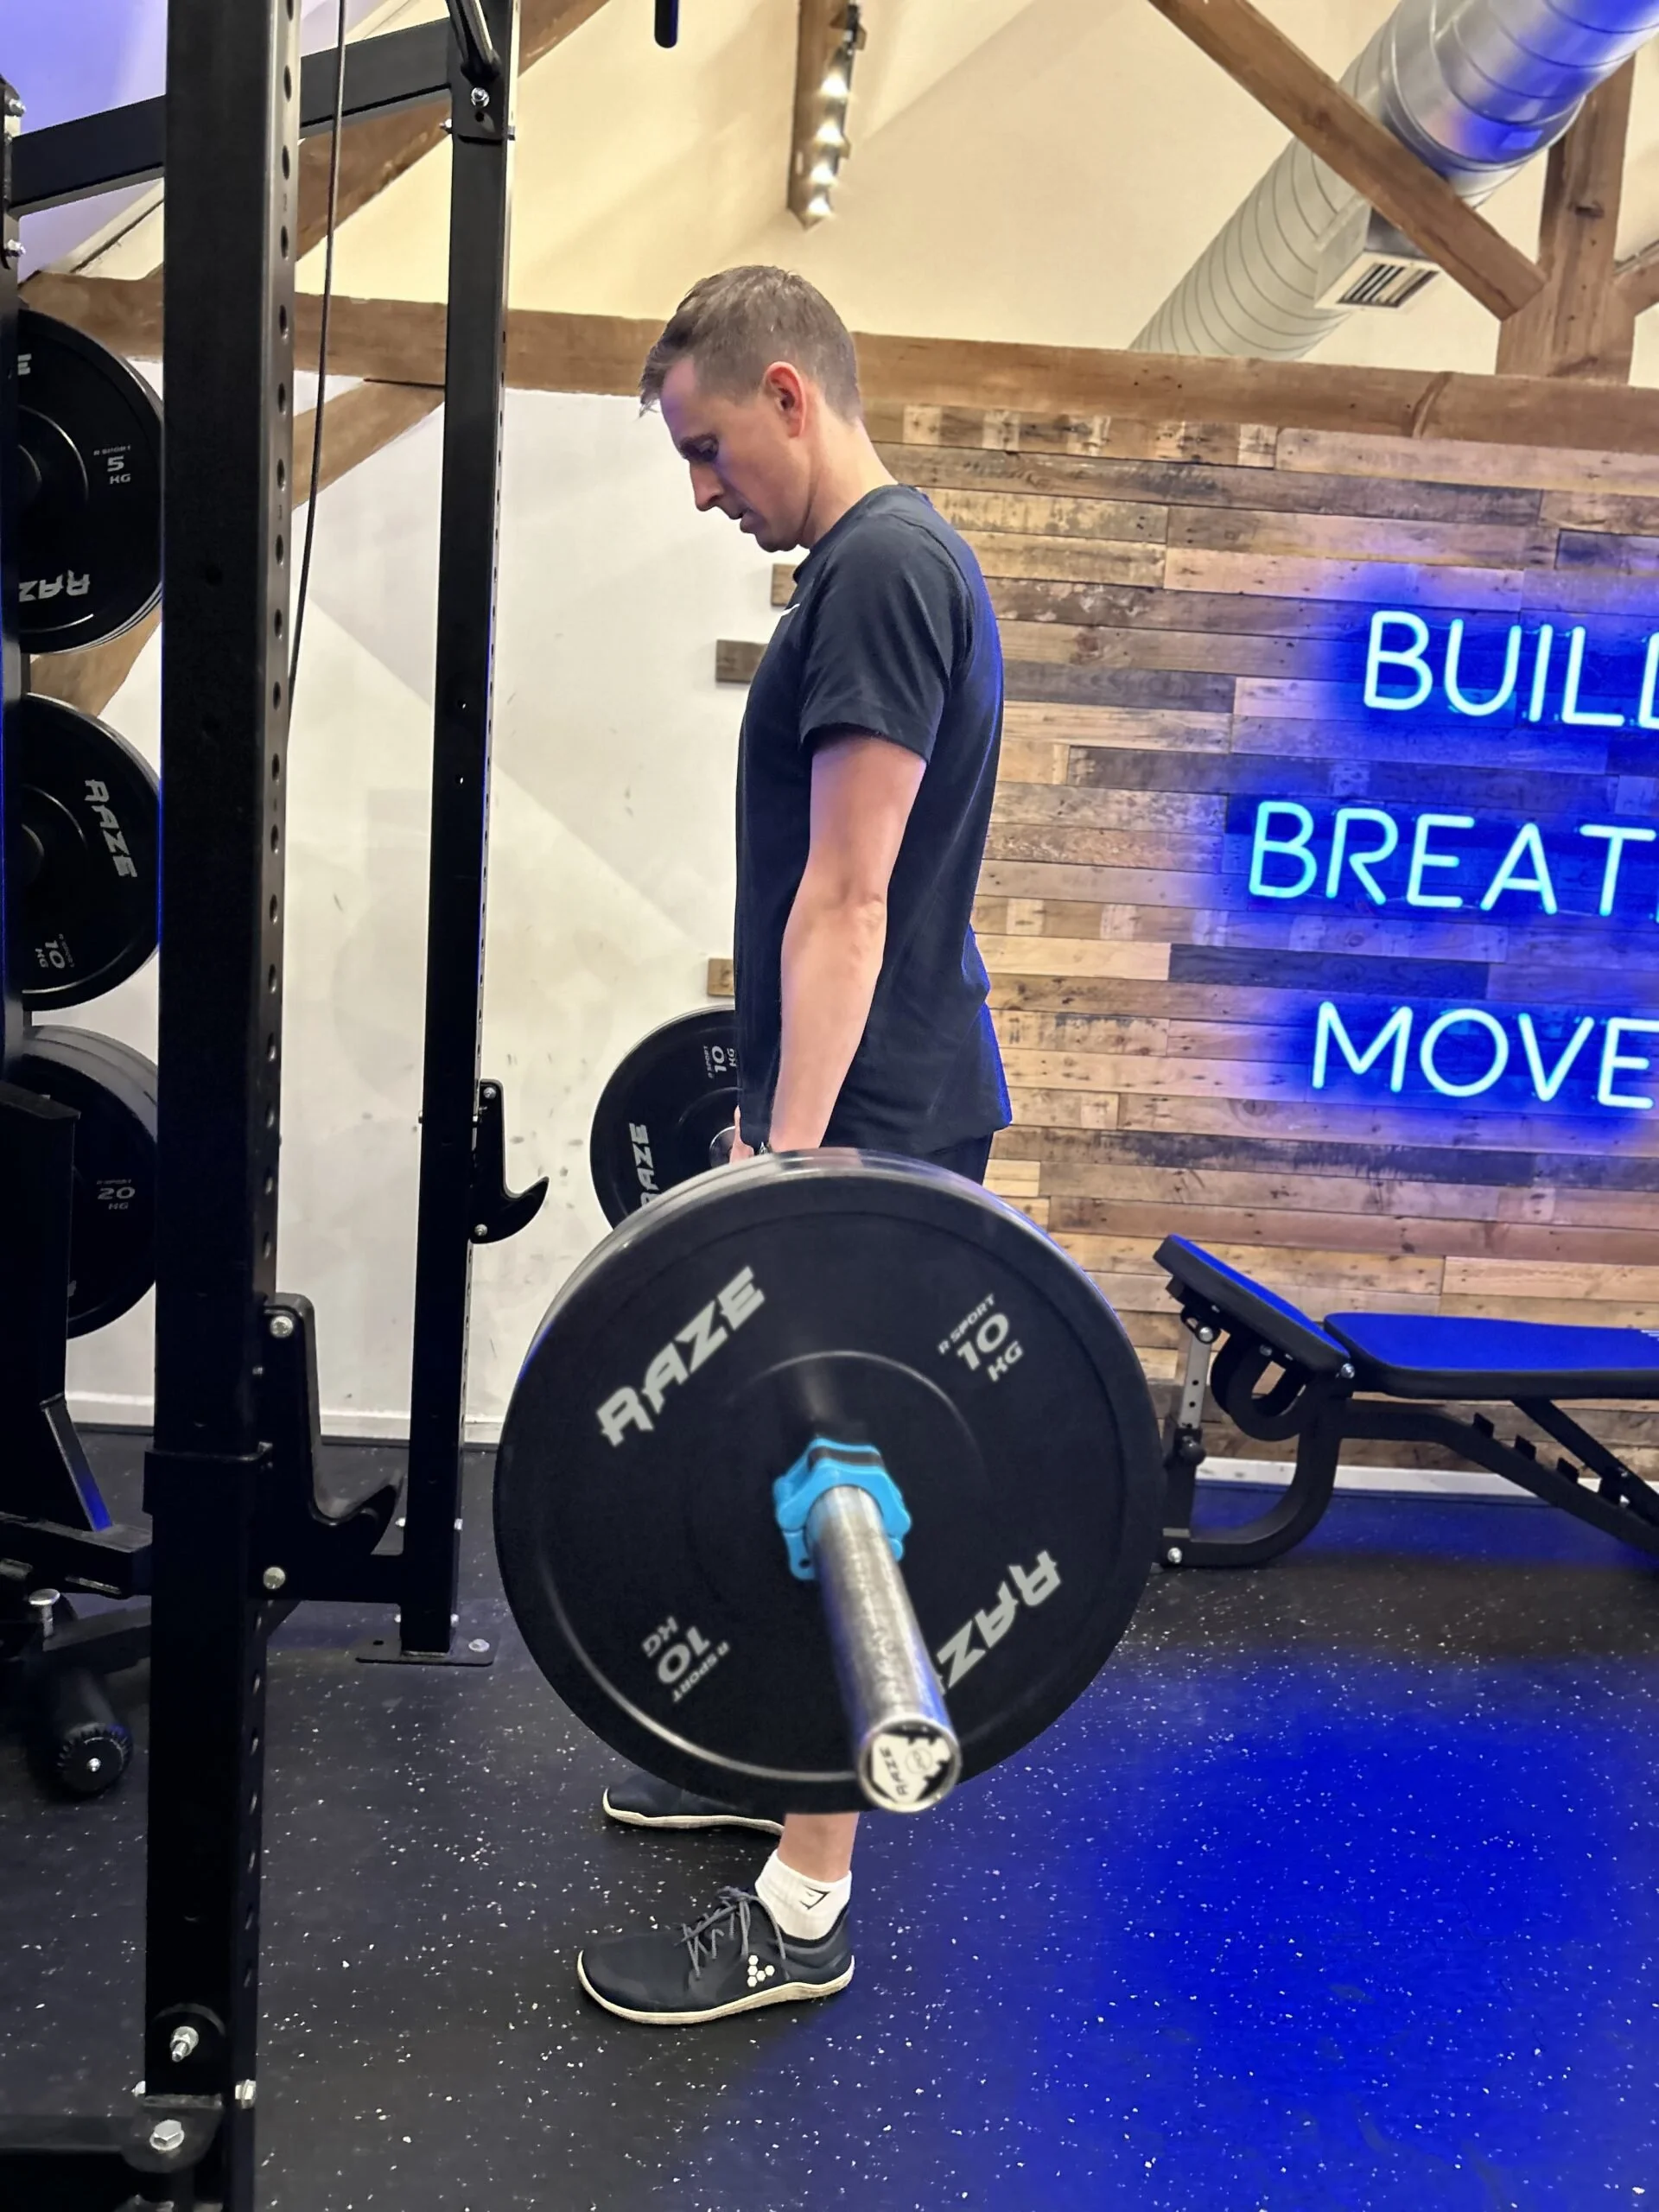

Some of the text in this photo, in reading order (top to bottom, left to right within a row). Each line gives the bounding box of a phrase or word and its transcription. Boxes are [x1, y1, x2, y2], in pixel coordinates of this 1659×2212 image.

[107, 455, 124, 472] 5
[110, 474, 130, 484] KG
[19, 569, 90, 602] RAZ
[85, 779, 137, 878] RAZE
[1249, 800, 1659, 924] BREAT
[45, 940, 65, 969] 10
[712, 1046, 727, 1073] 10
[727, 1047, 737, 1067] KG
[1312, 1001, 1659, 1109] MOVE
[98, 1186, 136, 1200] 20
[950, 1294, 995, 1343] SPORT
[595, 1265, 765, 1447] RAZE
[957, 1313, 1009, 1371] 10
[988, 1340, 1023, 1382] KG
[642, 1617, 678, 1658] KG
[937, 1550, 1061, 1696] RAZ
[658, 1625, 710, 1684] 10
